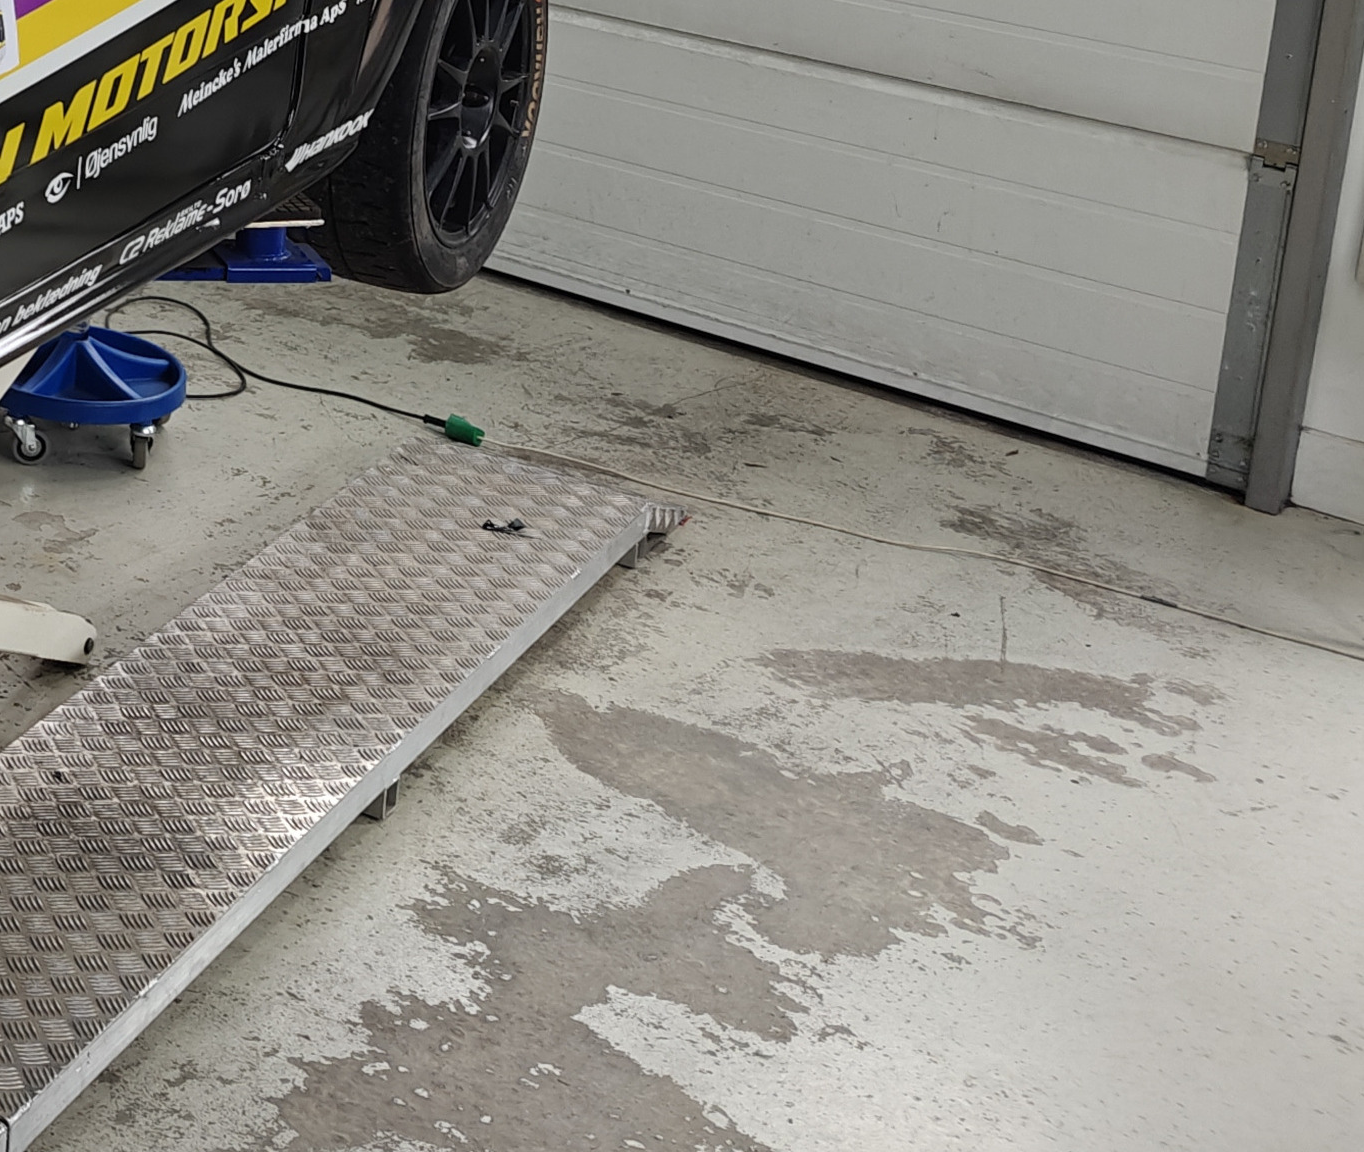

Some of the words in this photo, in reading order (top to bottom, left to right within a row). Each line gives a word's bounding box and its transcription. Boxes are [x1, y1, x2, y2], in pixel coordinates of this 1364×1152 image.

[177, 58, 242, 118] Meincke's
[85, 116, 158, 178] Øjensynlig
[120, 234, 146, 265] C2
[12, 264, 103, 326] beklædning
